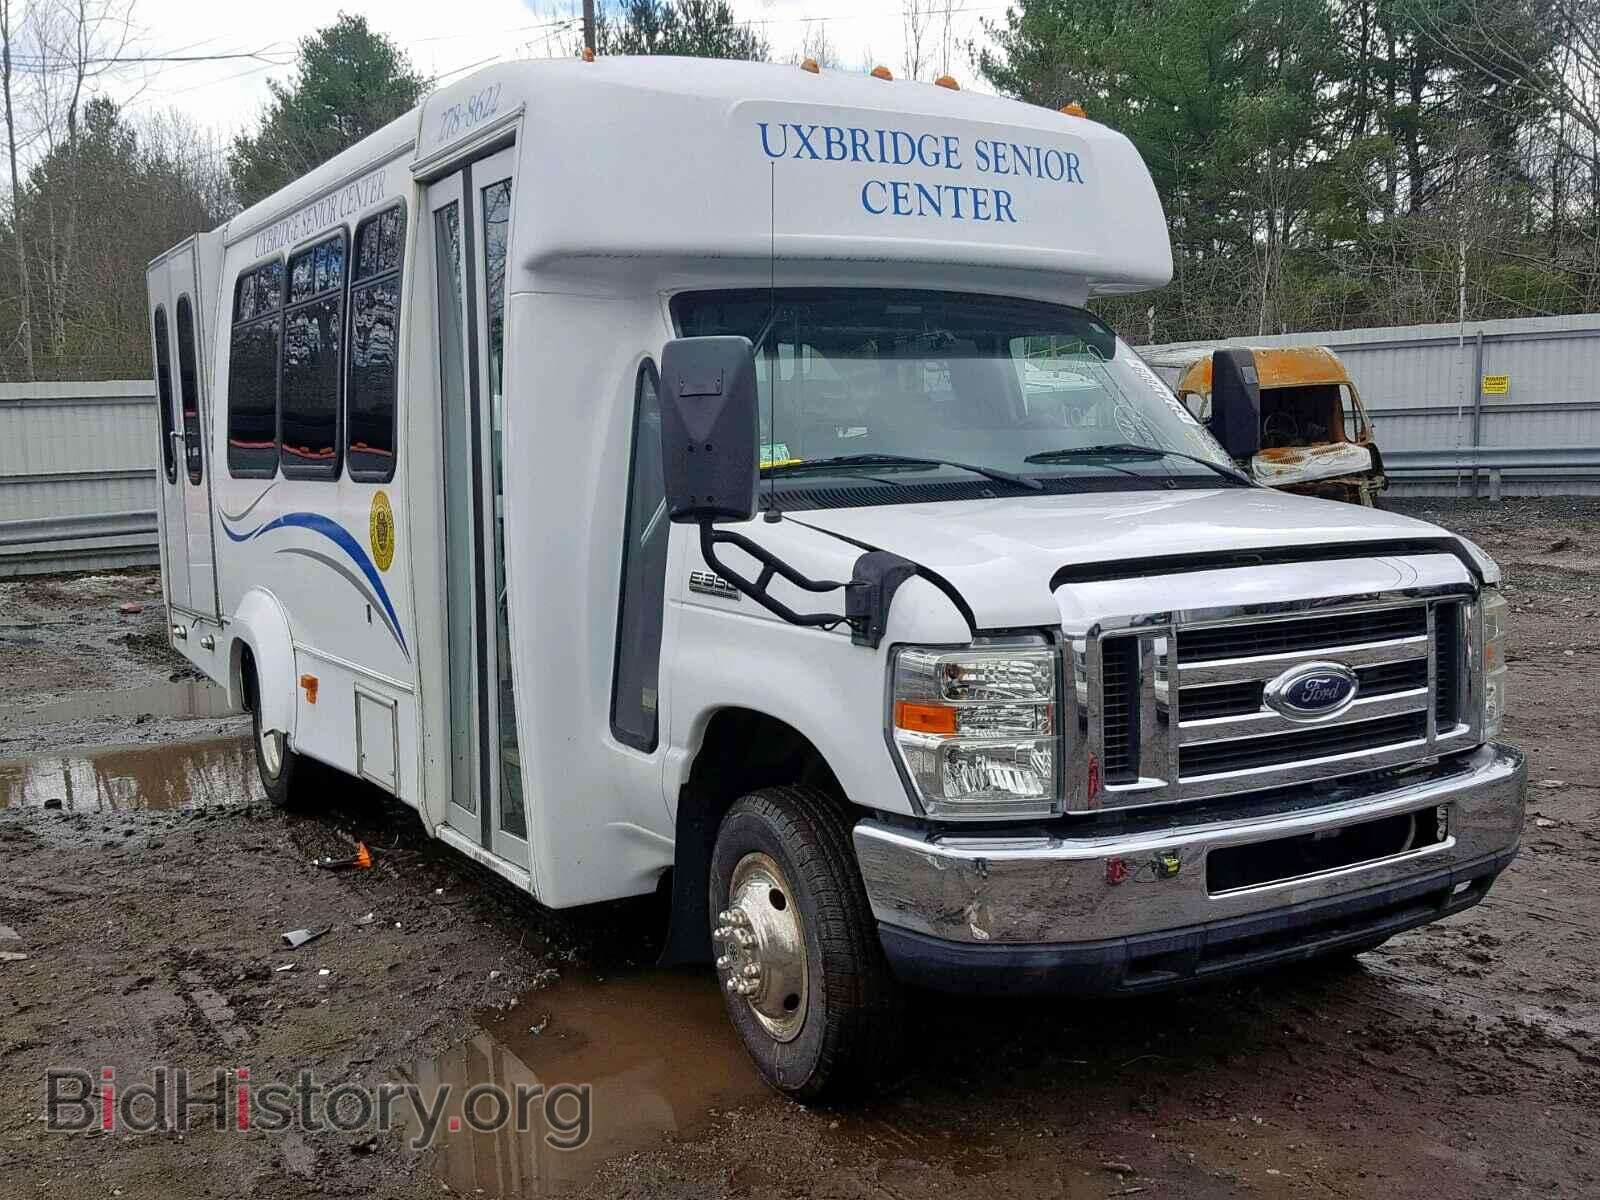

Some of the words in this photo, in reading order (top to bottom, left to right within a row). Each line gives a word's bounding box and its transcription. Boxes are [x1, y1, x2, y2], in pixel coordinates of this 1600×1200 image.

[438, 82, 502, 142] 278-8622
[757, 122, 962, 170] UXBRIDGE
[974, 138, 1084, 185] SENIOR
[255, 216, 299, 258] UXBRIDGE
[301, 194, 338, 237] SENIOR
[340, 169, 386, 218] CENTER
[861, 179, 1017, 222] CENTER
[1301, 678, 1341, 703] Ford
